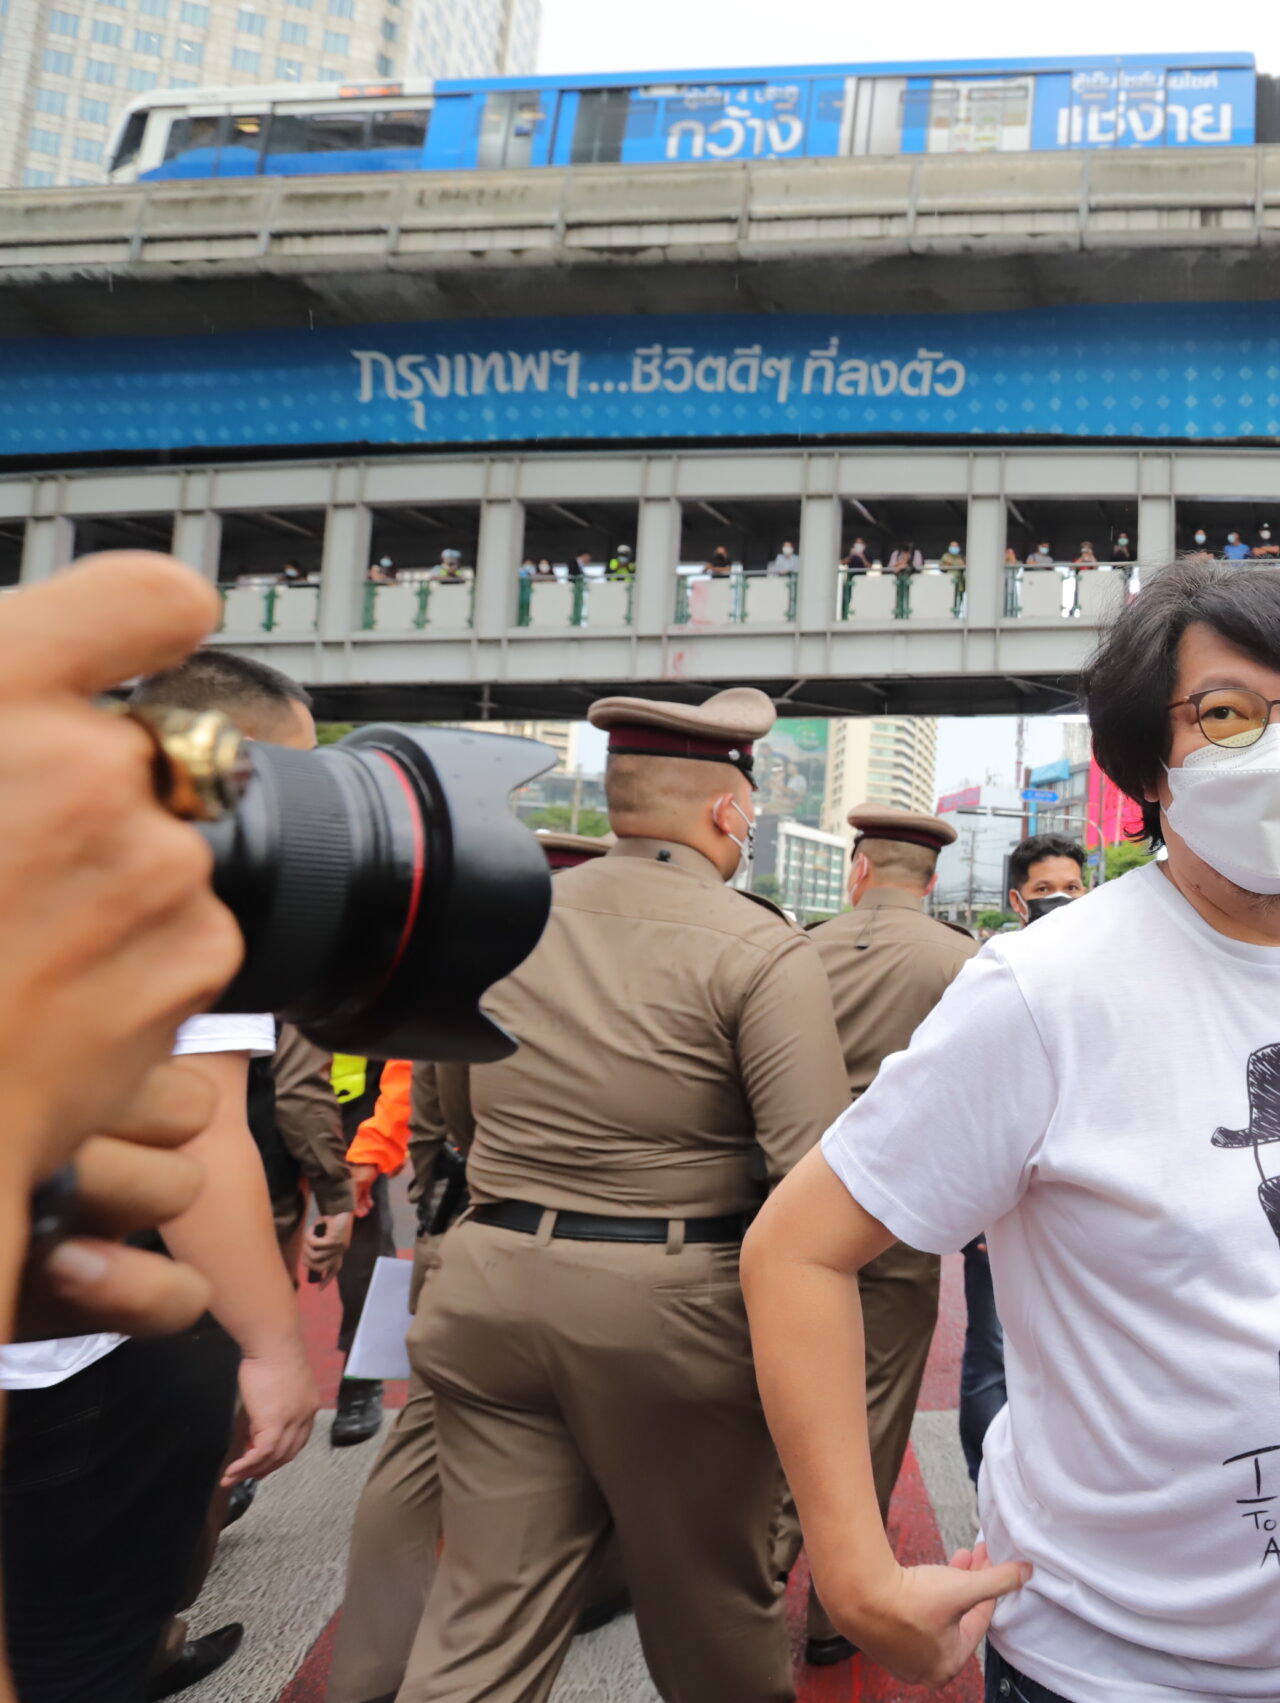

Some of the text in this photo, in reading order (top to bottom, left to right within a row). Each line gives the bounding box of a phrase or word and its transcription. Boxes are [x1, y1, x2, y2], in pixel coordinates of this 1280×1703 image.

[666, 105, 803, 159] กว้าง
[802, 336, 966, 397] ที่ลงตัว
[1241, 1510, 1277, 1532] To
